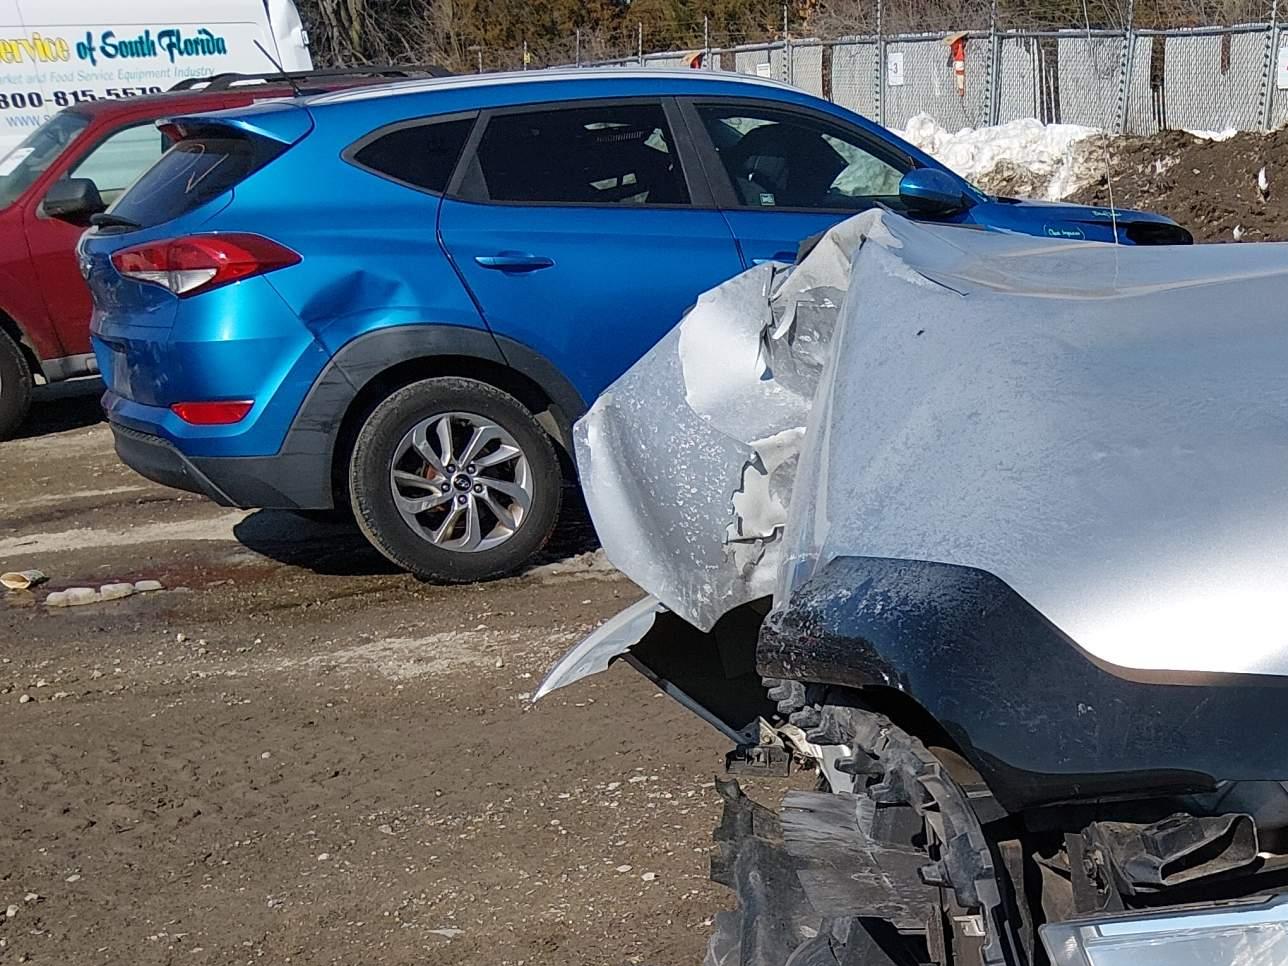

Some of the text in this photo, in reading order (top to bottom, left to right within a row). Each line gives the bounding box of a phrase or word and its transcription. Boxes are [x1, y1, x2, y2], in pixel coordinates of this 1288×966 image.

[76, 31, 97, 67] of
[100, 30, 157, 59] South
[157, 28, 227, 63] Florida
[50, 71, 74, 83] Food
[77, 69, 114, 82] Service
[118, 67, 170, 82] Equipment
[174, 66, 215, 79] Industry
